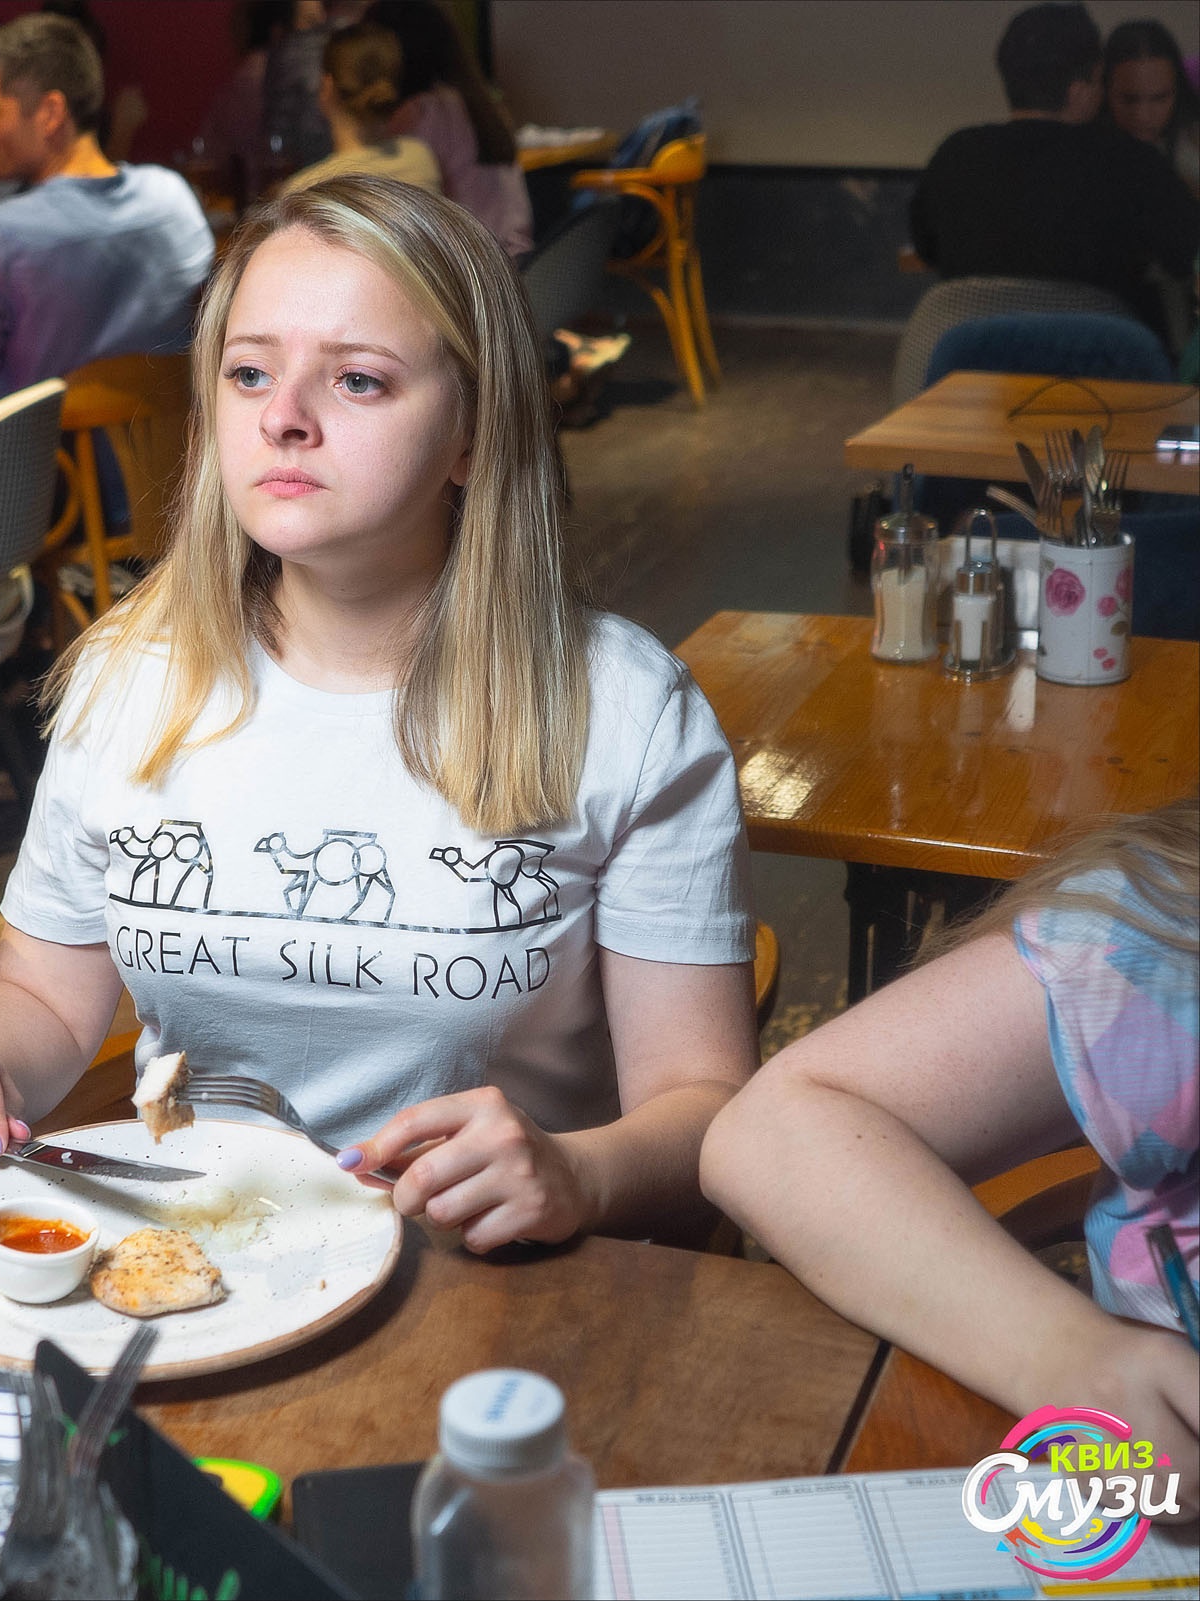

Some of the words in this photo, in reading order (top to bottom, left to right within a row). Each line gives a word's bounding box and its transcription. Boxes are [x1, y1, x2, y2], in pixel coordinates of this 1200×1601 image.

[115, 926, 250, 977] GREAT
[279, 939, 384, 989] SILK
[413, 947, 551, 1001] ROAD
